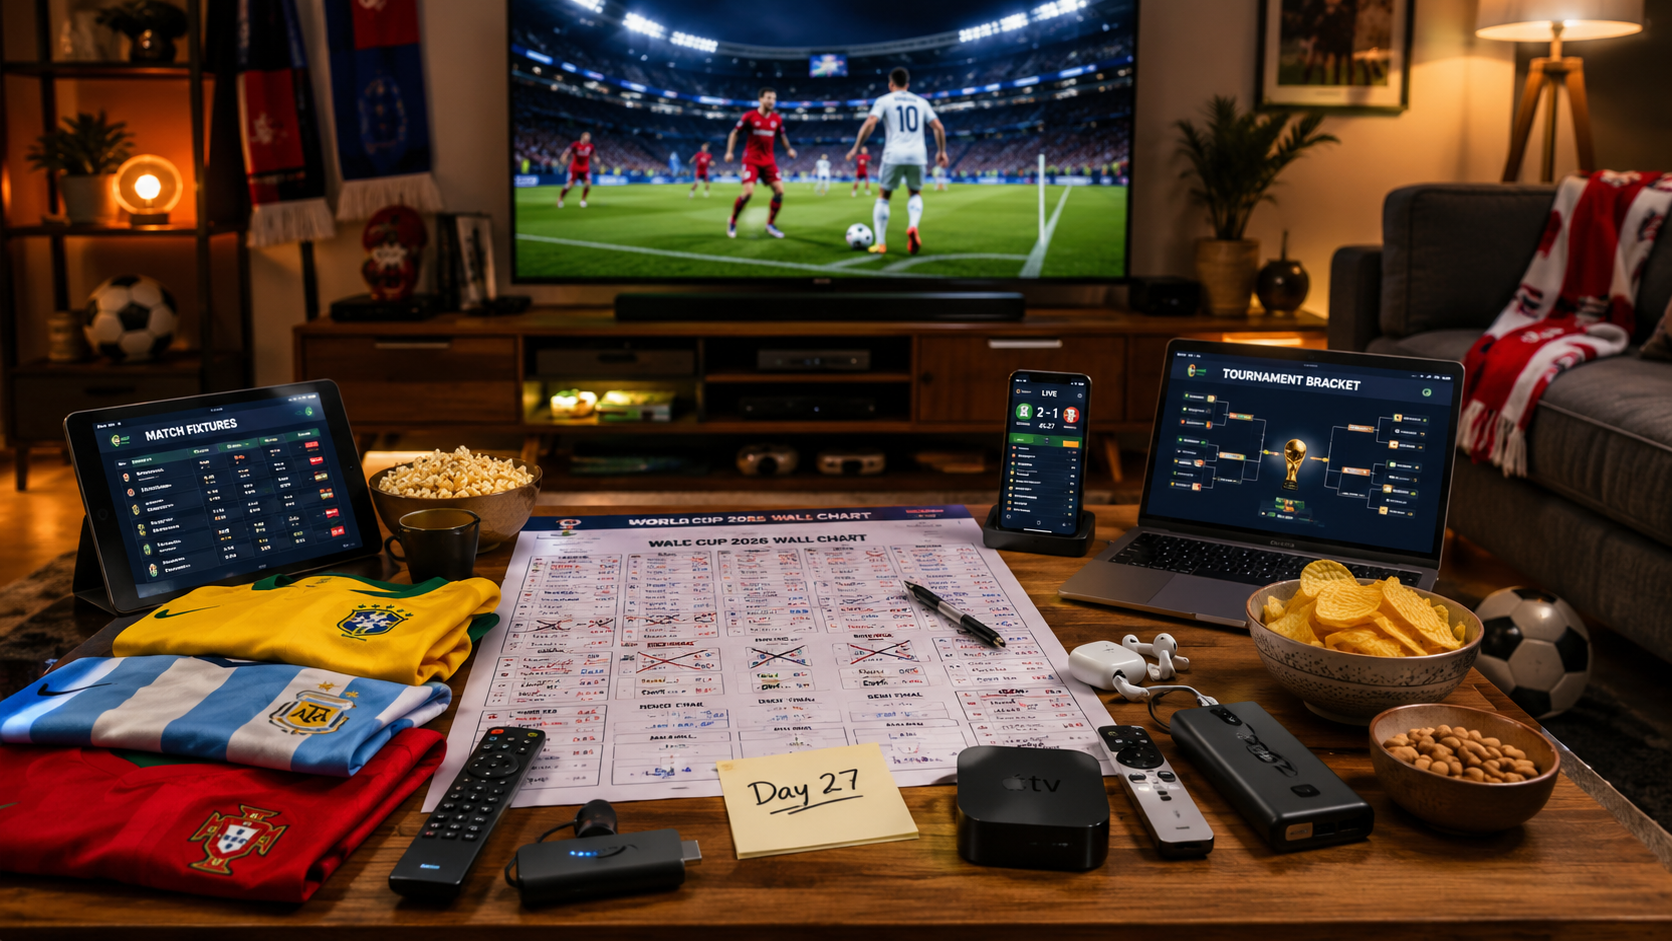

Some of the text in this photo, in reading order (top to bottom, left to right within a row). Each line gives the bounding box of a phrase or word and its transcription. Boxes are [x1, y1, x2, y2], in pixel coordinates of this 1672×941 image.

[896, 105, 918, 133] 10
[1223, 368, 1361, 391] TOURNAMENT BRACKET
[145, 418, 238, 442] MATCH FIXTURES
[691, 516, 724, 524] CUP
[770, 513, 814, 521] WALL
[816, 511, 872, 520] CHART
[695, 538, 727, 547] CUP
[731, 537, 769, 546] 2026
[772, 536, 814, 544] WALL
[816, 533, 867, 543] CHART
[747, 768, 858, 807] Day 27
[1028, 775, 1061, 793] tv
